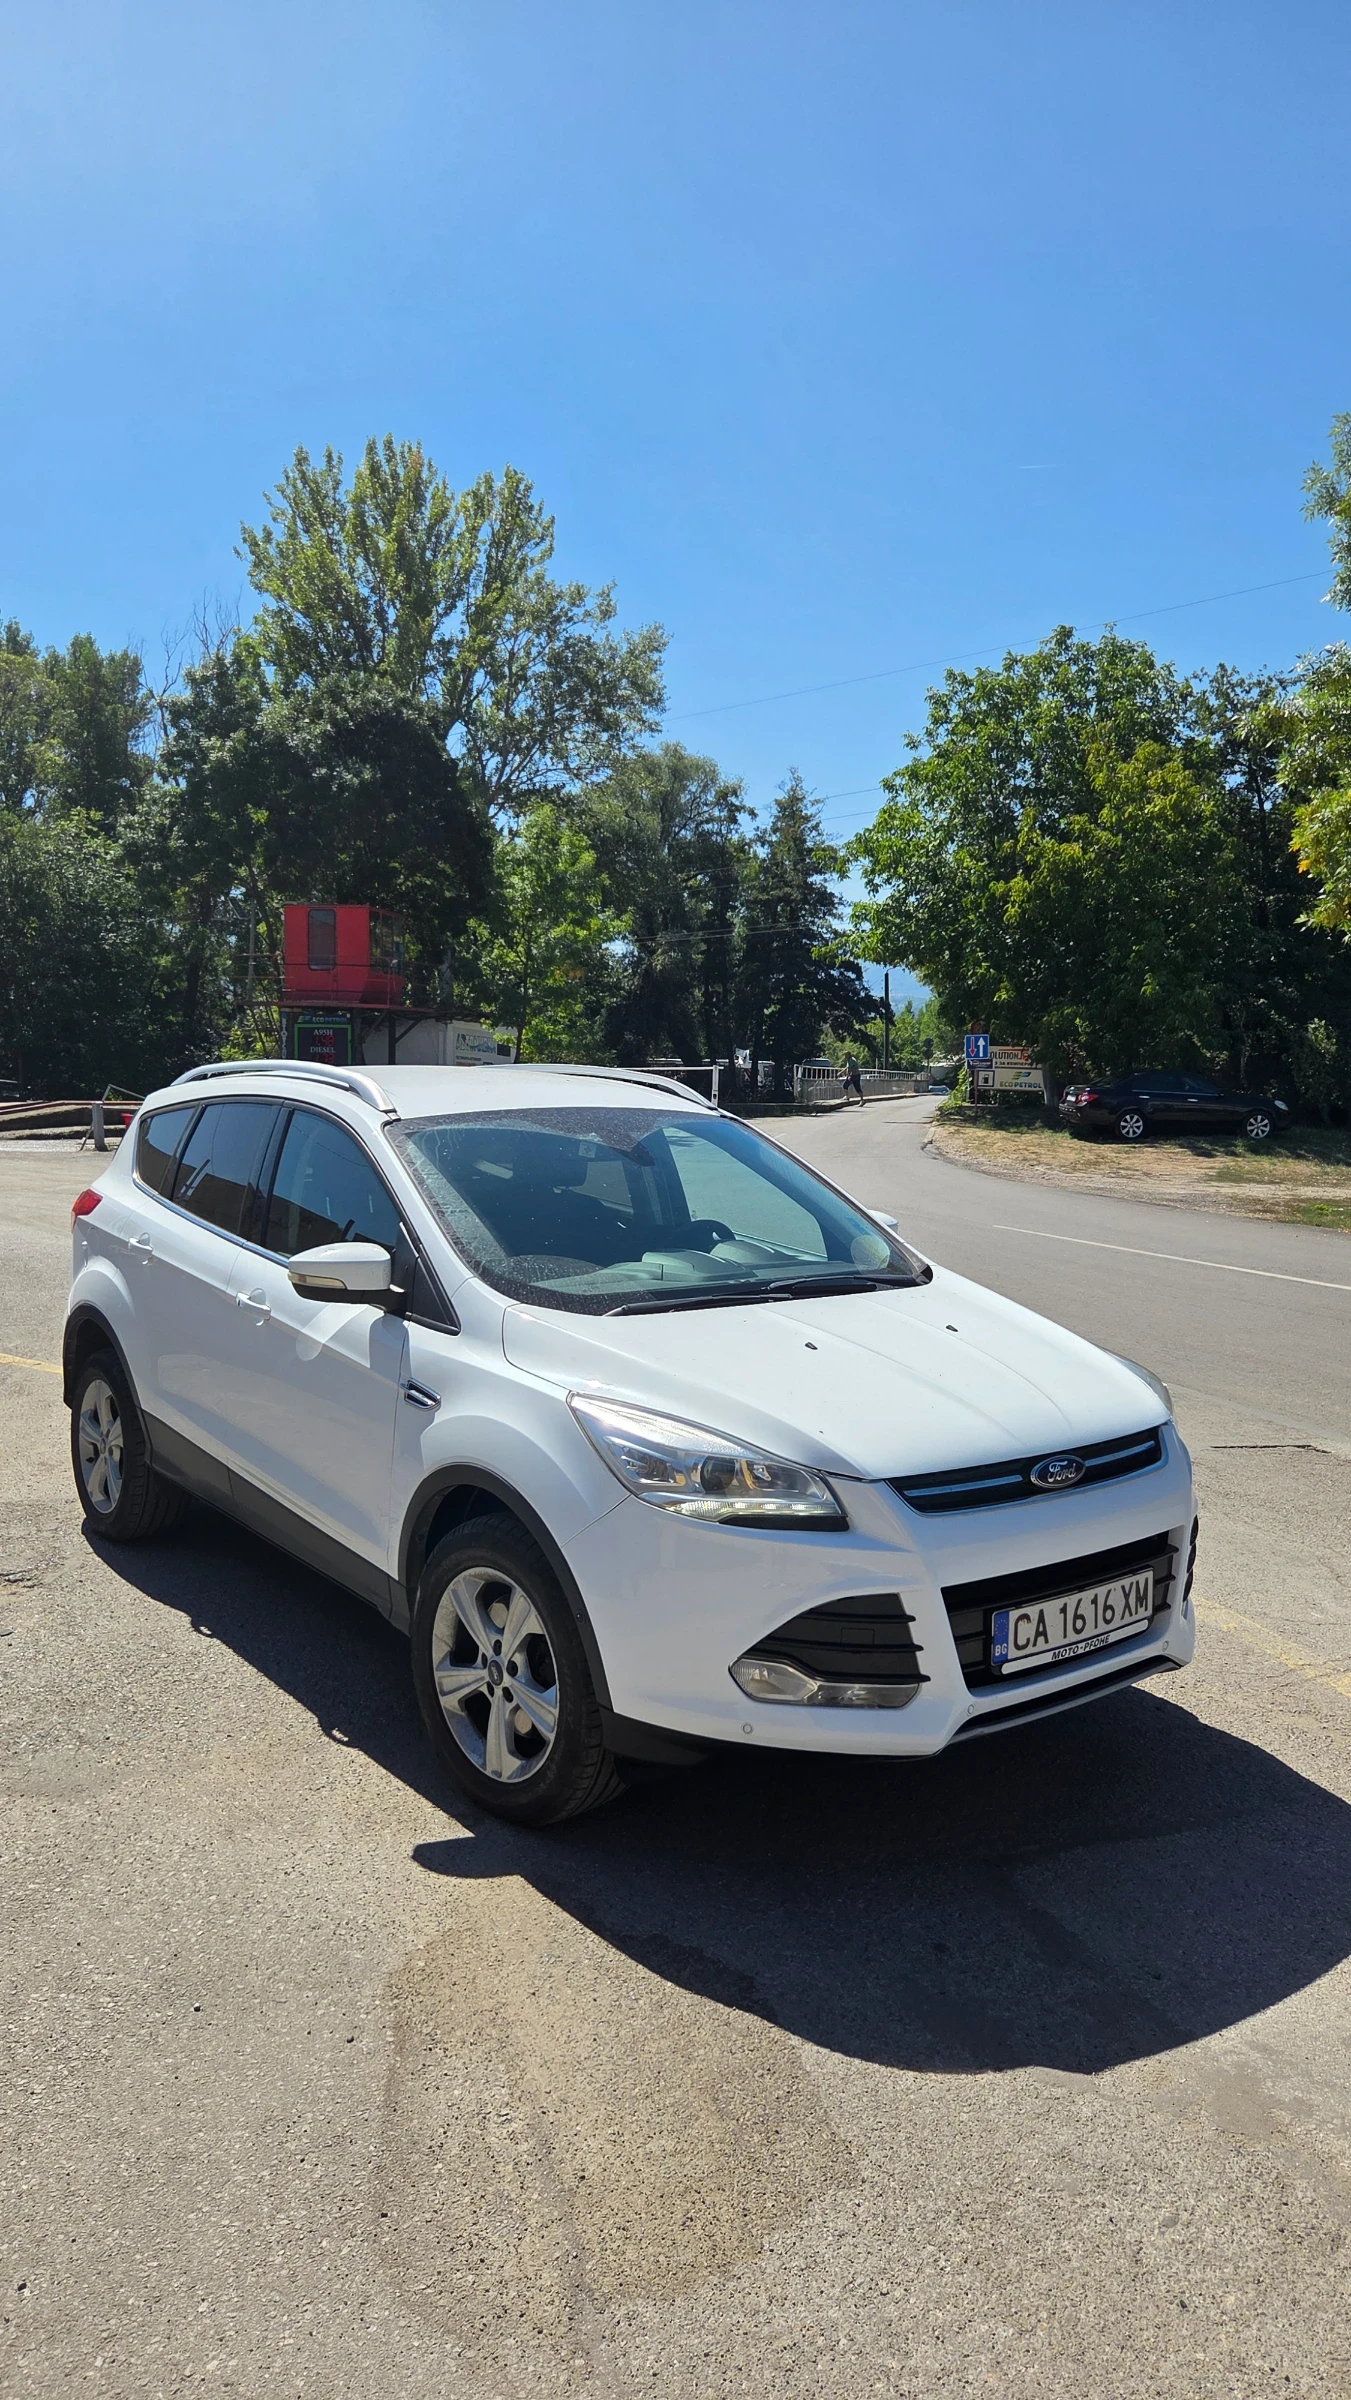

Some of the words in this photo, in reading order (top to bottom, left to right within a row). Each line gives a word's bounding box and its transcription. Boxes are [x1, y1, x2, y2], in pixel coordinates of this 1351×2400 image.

[989, 1051, 1019, 1060] OLUTION
[1047, 1460, 1077, 1483] Ford
[1013, 1608, 1050, 1651] CA
[1059, 1588, 1116, 1639] 1616
[1120, 1576, 1149, 1621] XM
[995, 1643, 1008, 1656] BG
[1051, 1634, 1111, 1661] MOTO-PFOHE
